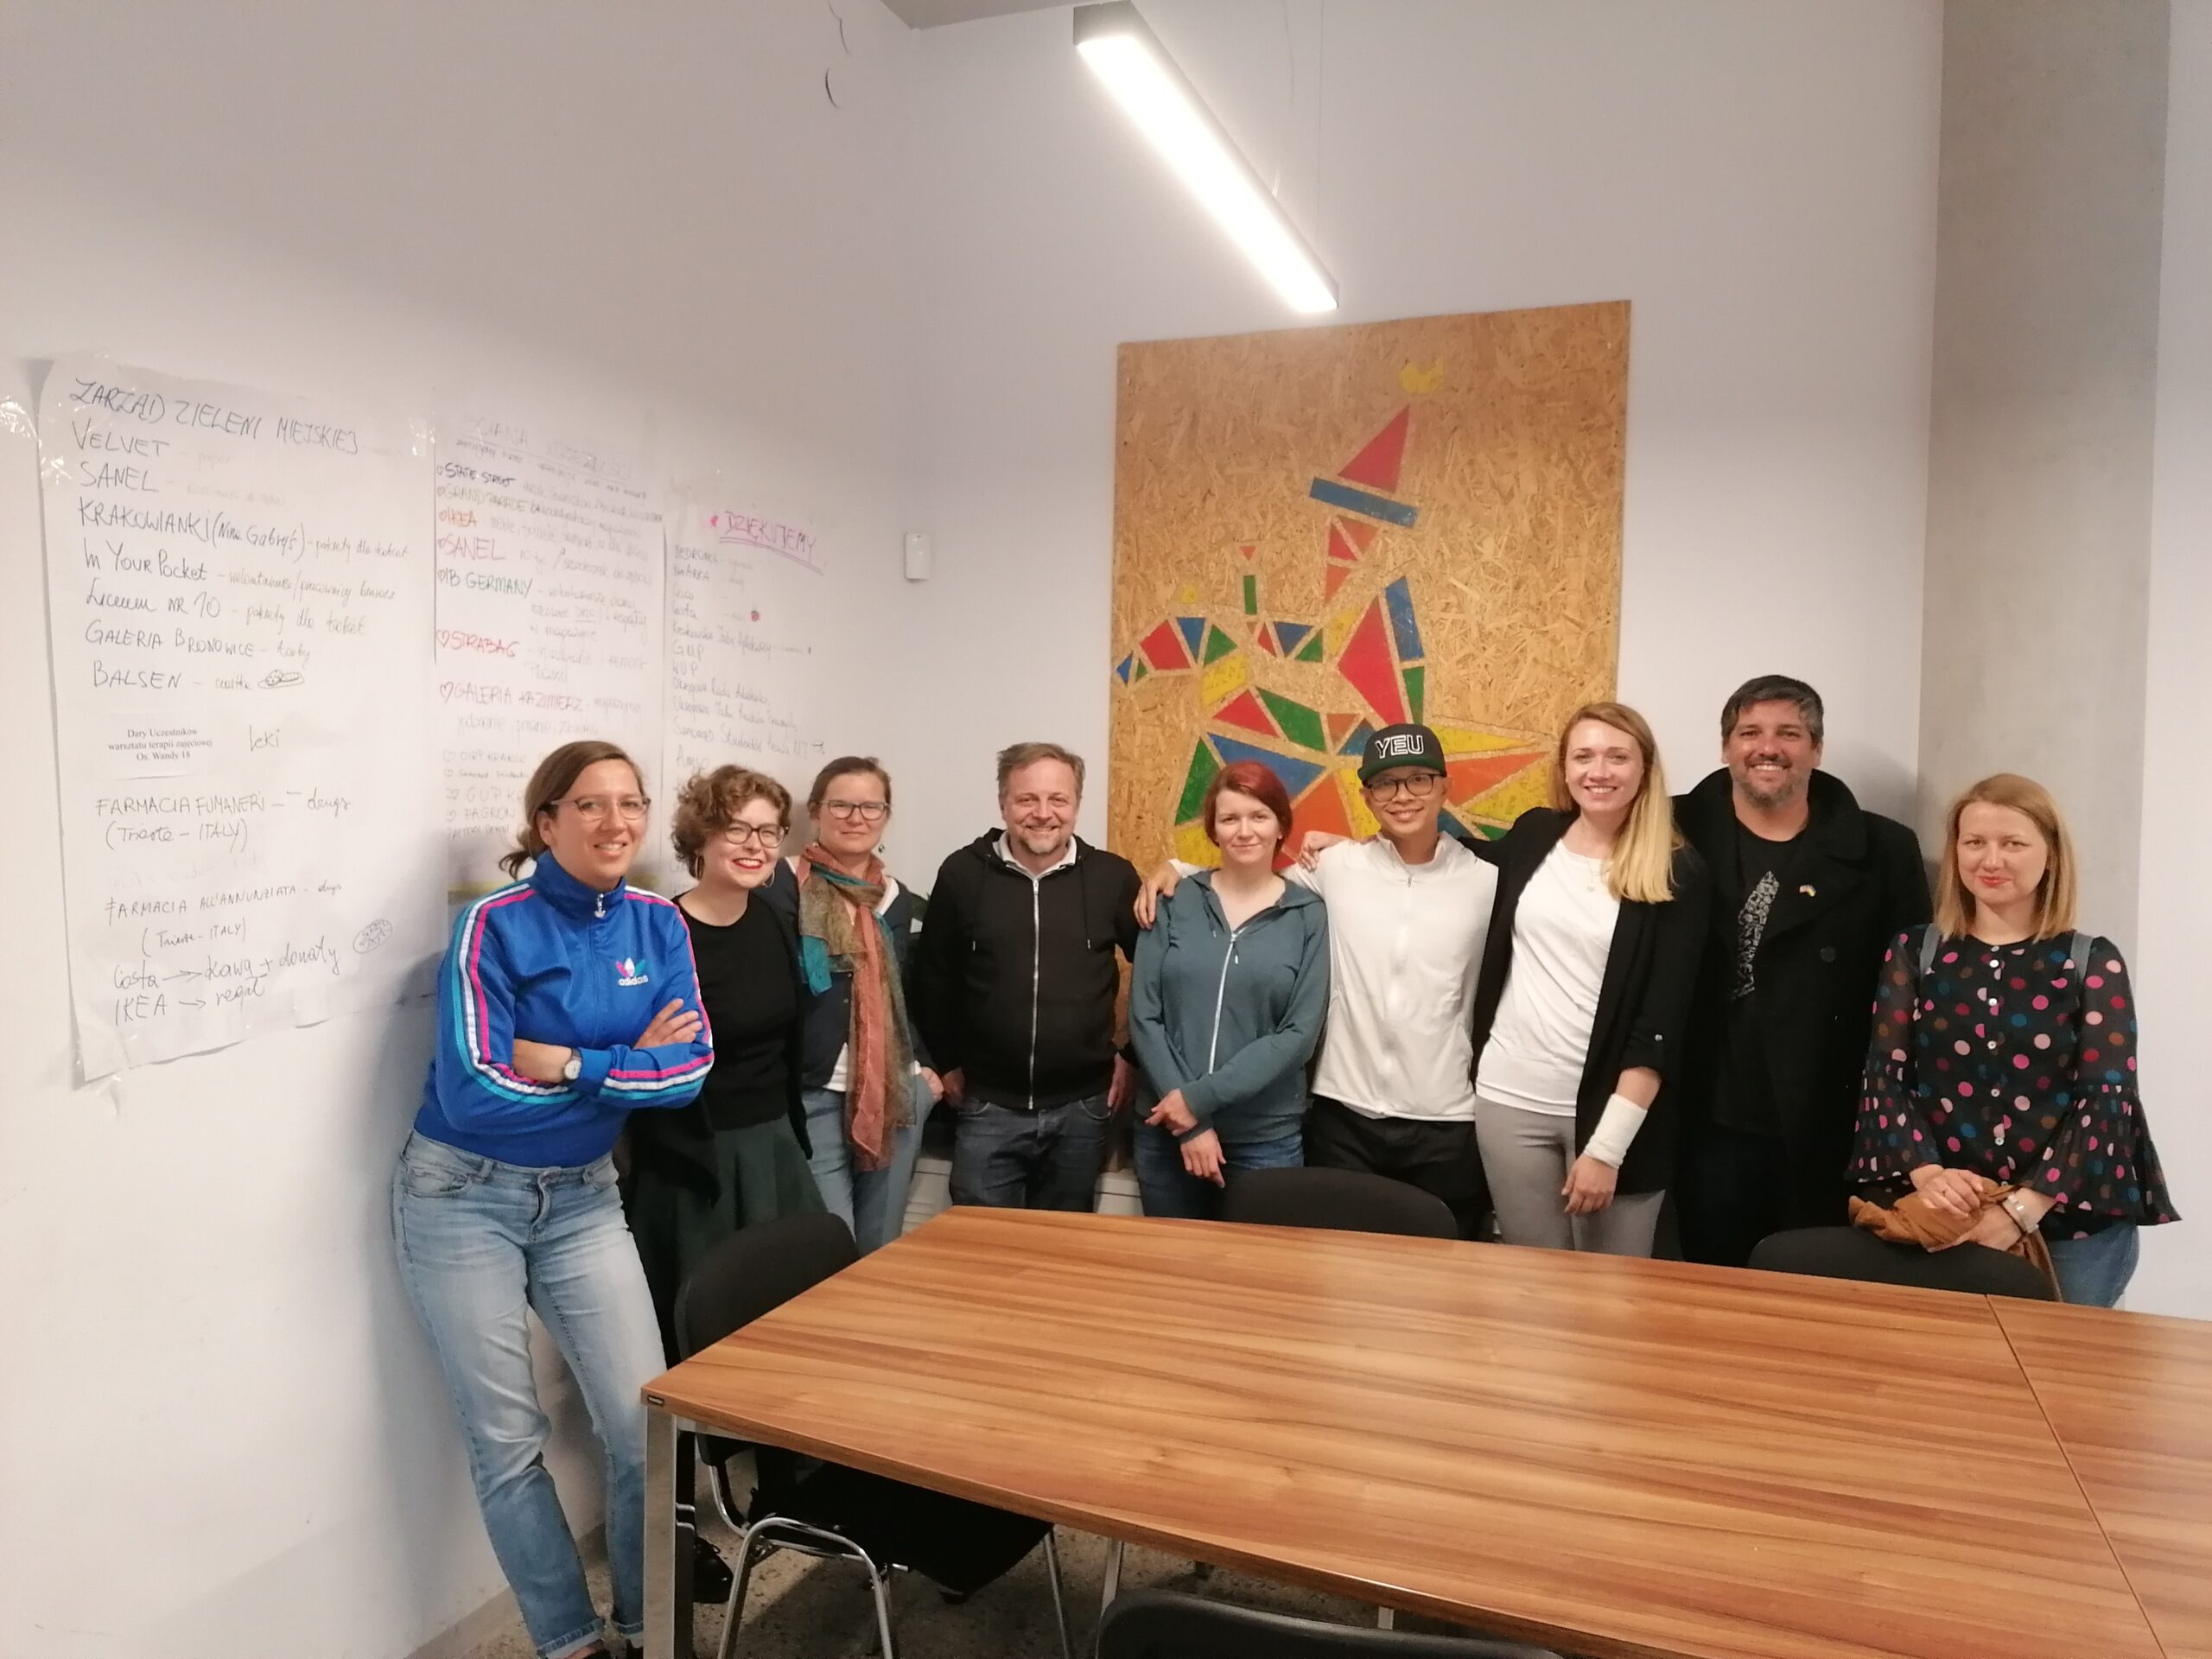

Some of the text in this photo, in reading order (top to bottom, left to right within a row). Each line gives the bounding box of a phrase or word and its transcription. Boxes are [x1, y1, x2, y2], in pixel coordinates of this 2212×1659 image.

[174, 400, 262, 439] ZIELENI
[72, 418, 170, 456] VELVET
[79, 461, 159, 492] SANEL
[445, 532, 507, 561] SANEL
[466, 572, 533, 598] GERMANY
[194, 591, 221, 619] 10
[86, 620, 162, 650] GALERIA
[175, 628, 255, 658] BRONOWICE
[450, 631, 520, 658] STRABAG
[93, 660, 183, 690] BALSEN
[454, 683, 512, 706] GALERIA
[108, 742, 146, 751] warsztatu
[149, 741, 174, 750] terapii
[127, 728, 197, 739] Dary Uczestników
[1375, 734, 1424, 759] YEU
[152, 751, 178, 761] Wandy
[95, 794, 191, 817] FARMACIA
[105, 897, 188, 926] FARMACIA
[116, 995, 166, 1027] IKEA
